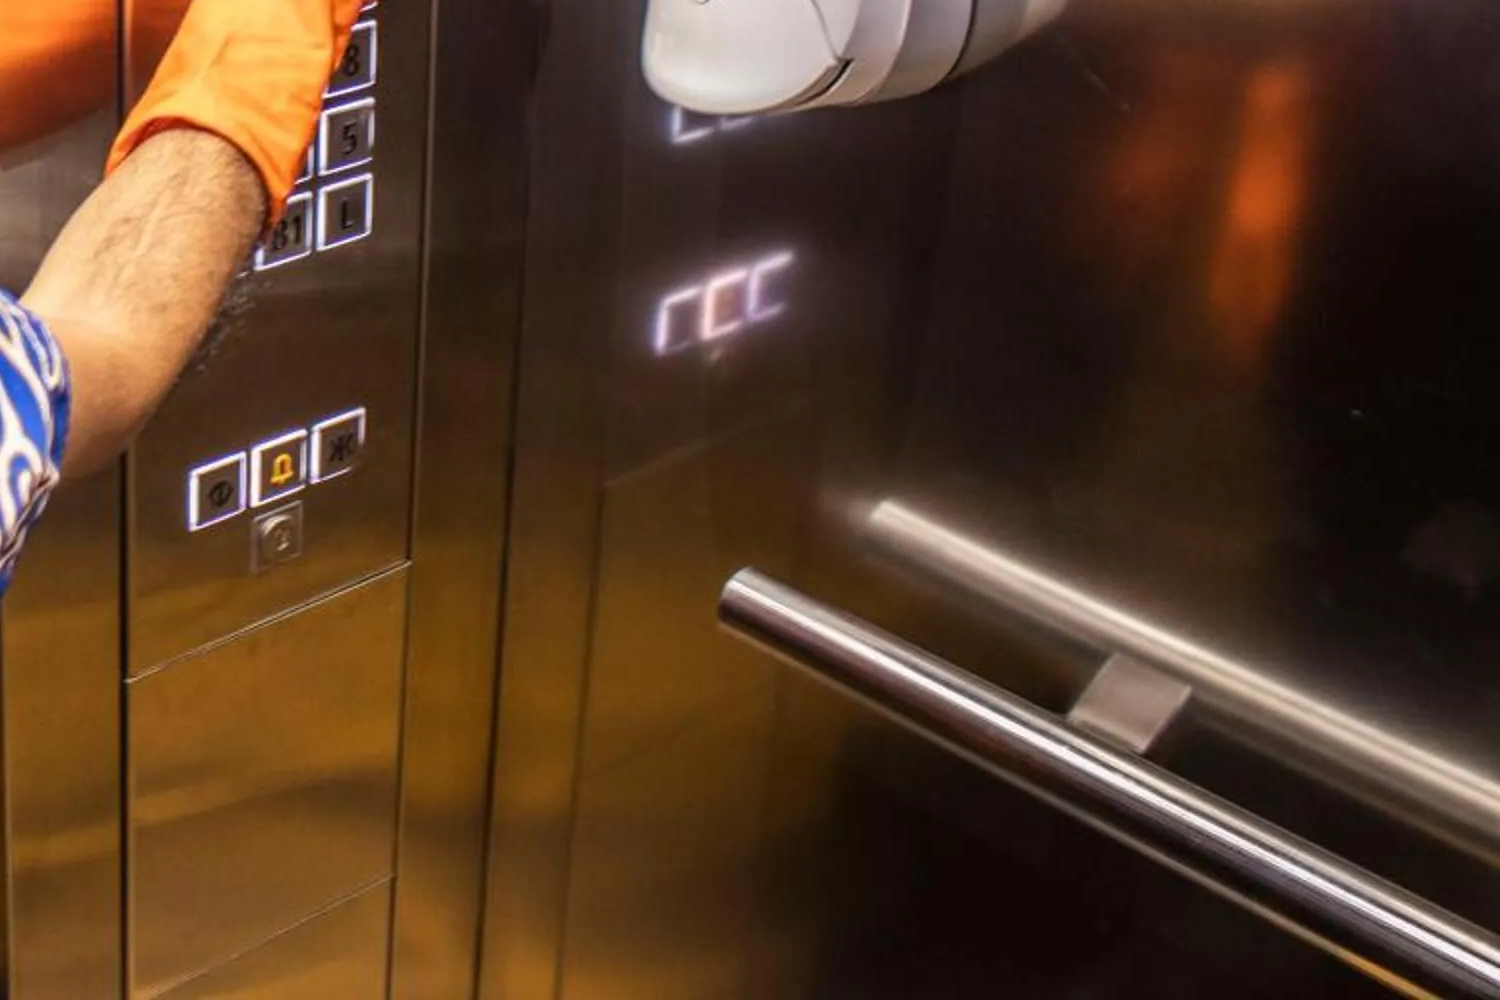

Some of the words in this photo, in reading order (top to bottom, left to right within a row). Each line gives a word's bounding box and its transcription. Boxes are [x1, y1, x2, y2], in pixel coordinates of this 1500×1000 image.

[342, 42, 360, 78] 8
[341, 121, 358, 155] 5
[339, 200, 354, 229] L
